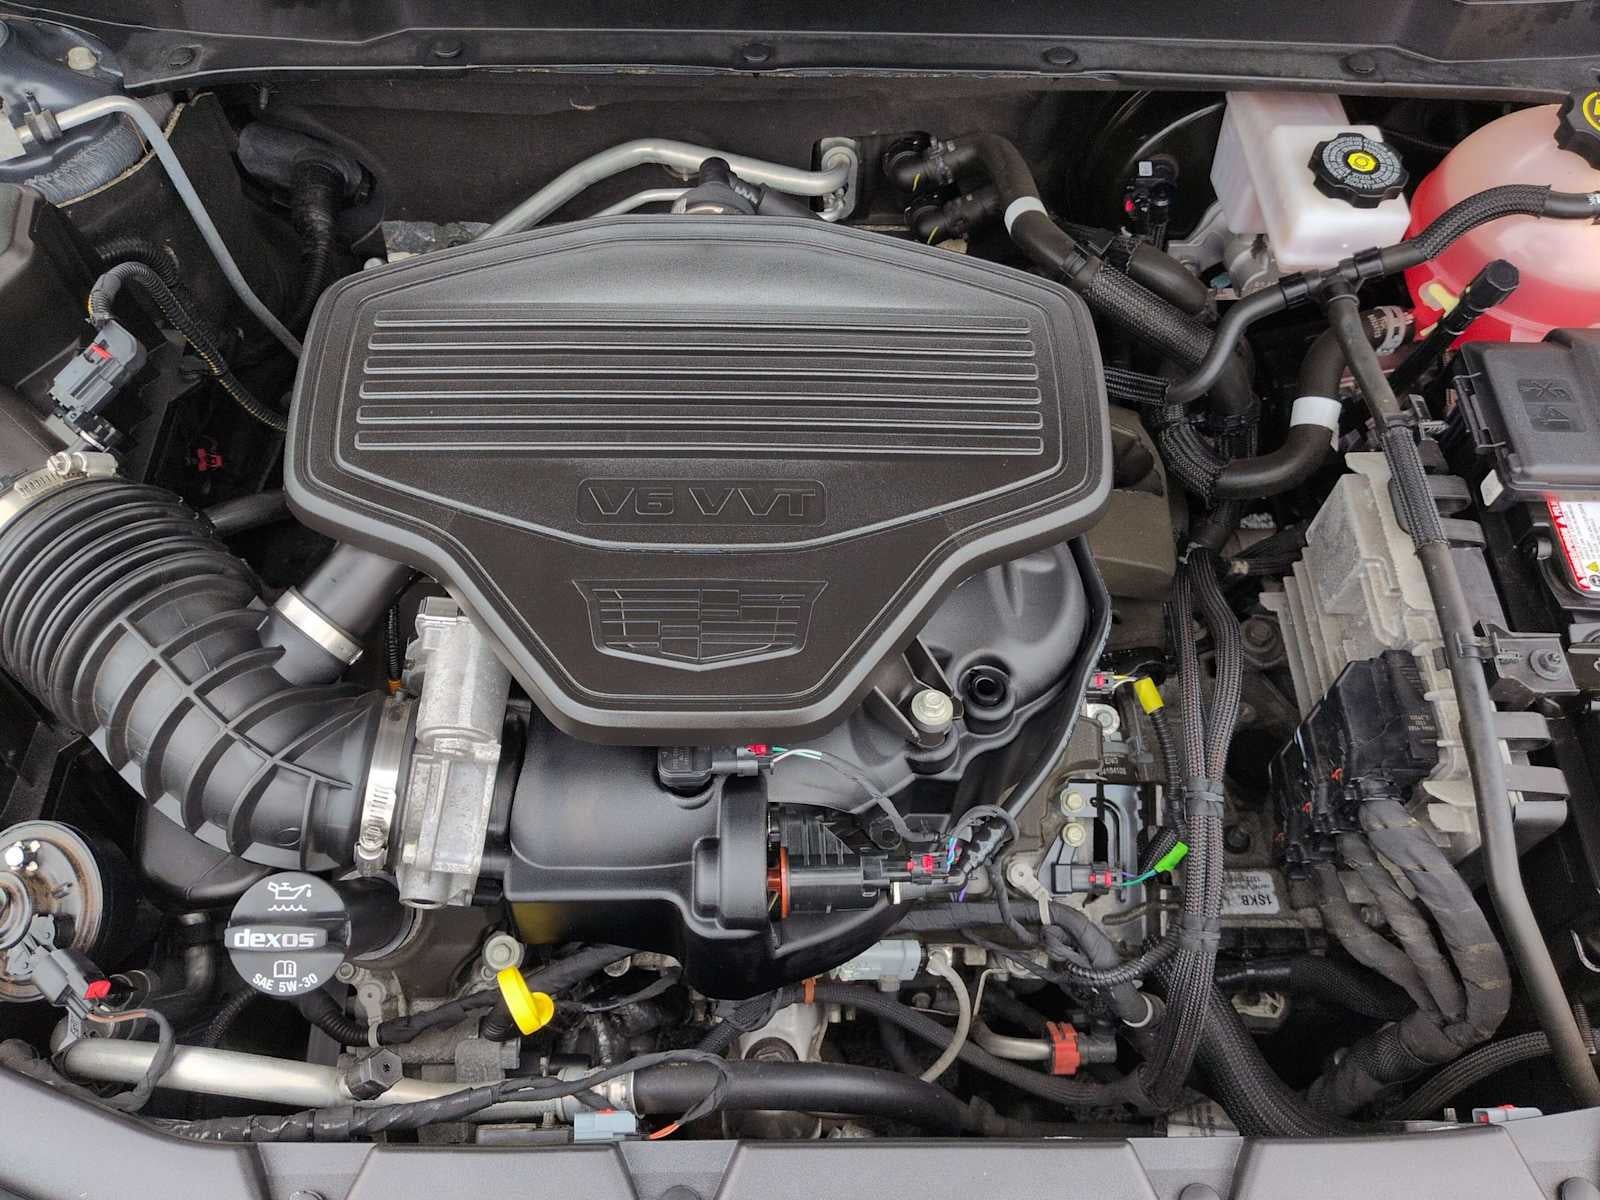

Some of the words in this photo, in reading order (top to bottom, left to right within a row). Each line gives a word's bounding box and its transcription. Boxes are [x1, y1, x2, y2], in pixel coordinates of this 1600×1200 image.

[588, 487, 674, 515] V6
[688, 487, 816, 517] VVT
[234, 928, 315, 948] dexos
[252, 973, 274, 991] SAE
[279, 973, 318, 992] 5W-30
